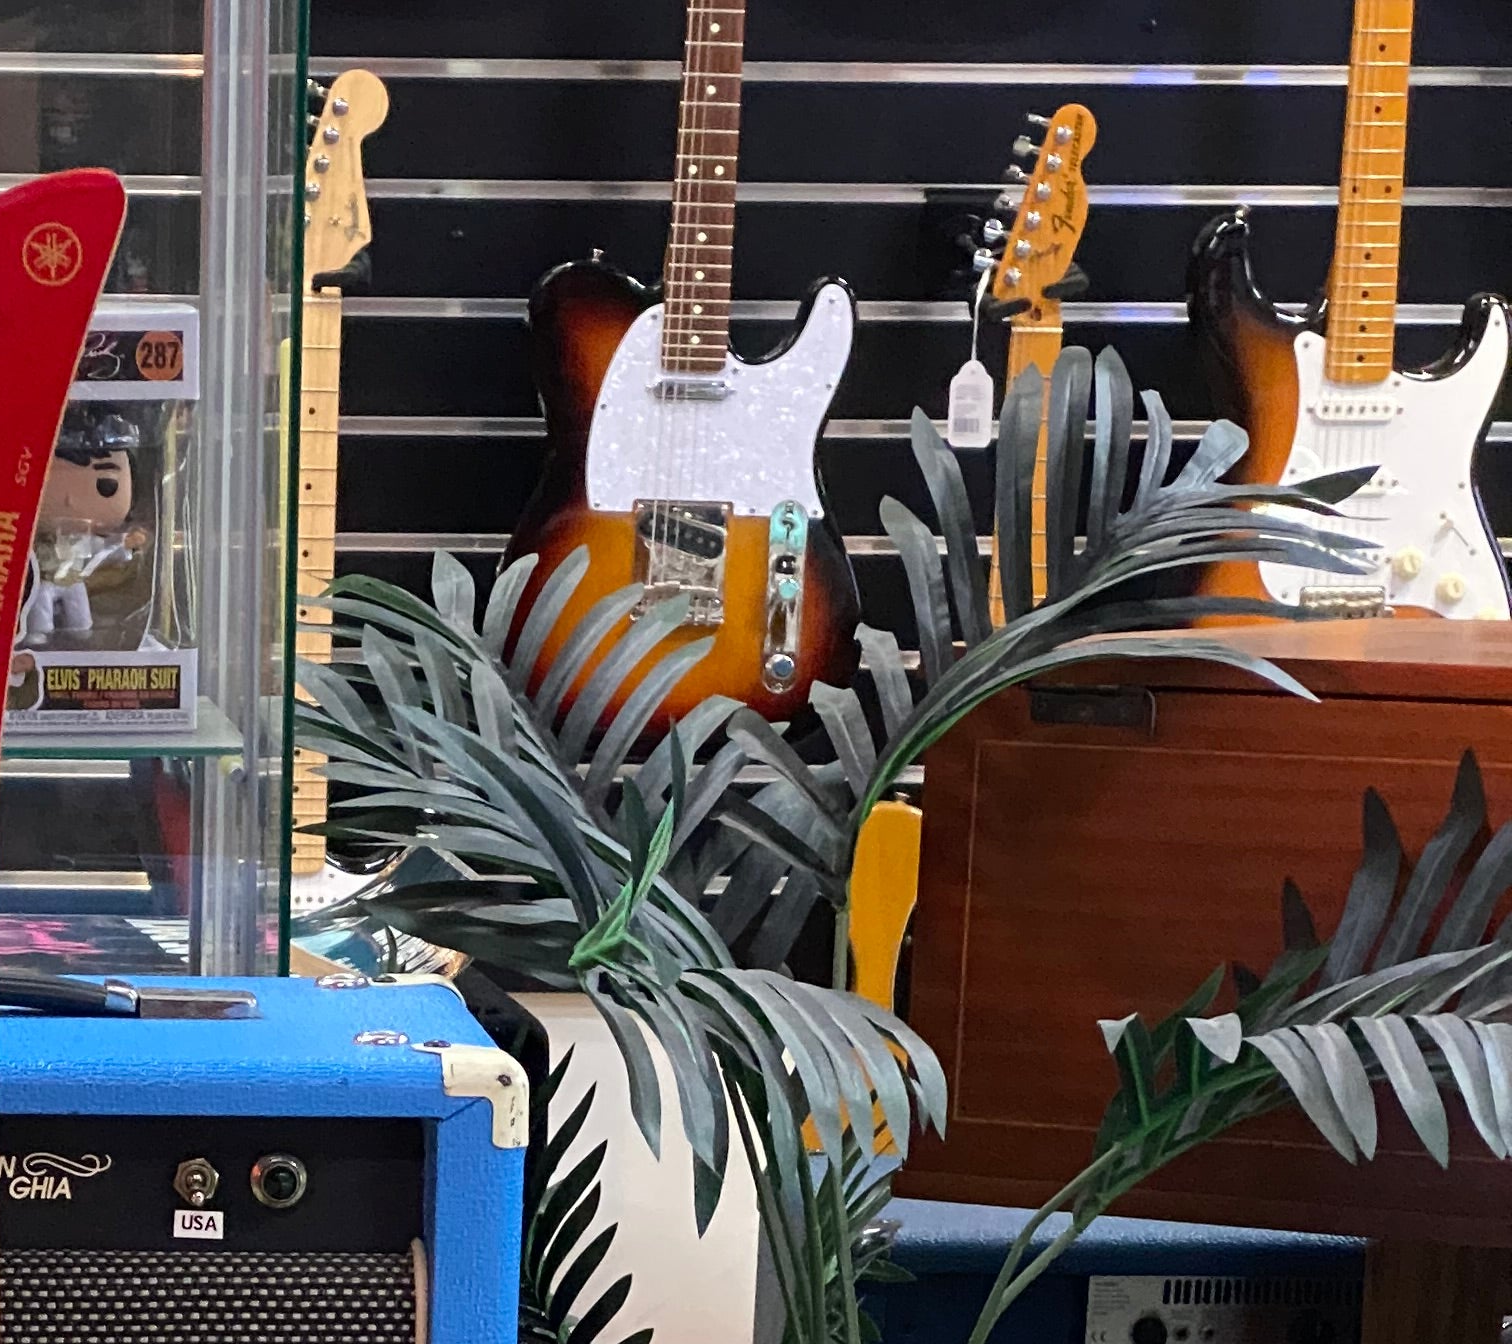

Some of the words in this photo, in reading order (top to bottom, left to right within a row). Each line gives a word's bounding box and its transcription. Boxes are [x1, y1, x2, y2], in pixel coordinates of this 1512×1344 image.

[140, 341, 180, 369] 287
[14, 446, 33, 487] SGV
[46, 669, 81, 690] ELVIS
[88, 668, 148, 690] PHARAOH
[150, 667, 179, 690] SUIT
[9, 1176, 72, 1200] GHIA
[180, 1215, 217, 1232] USA
